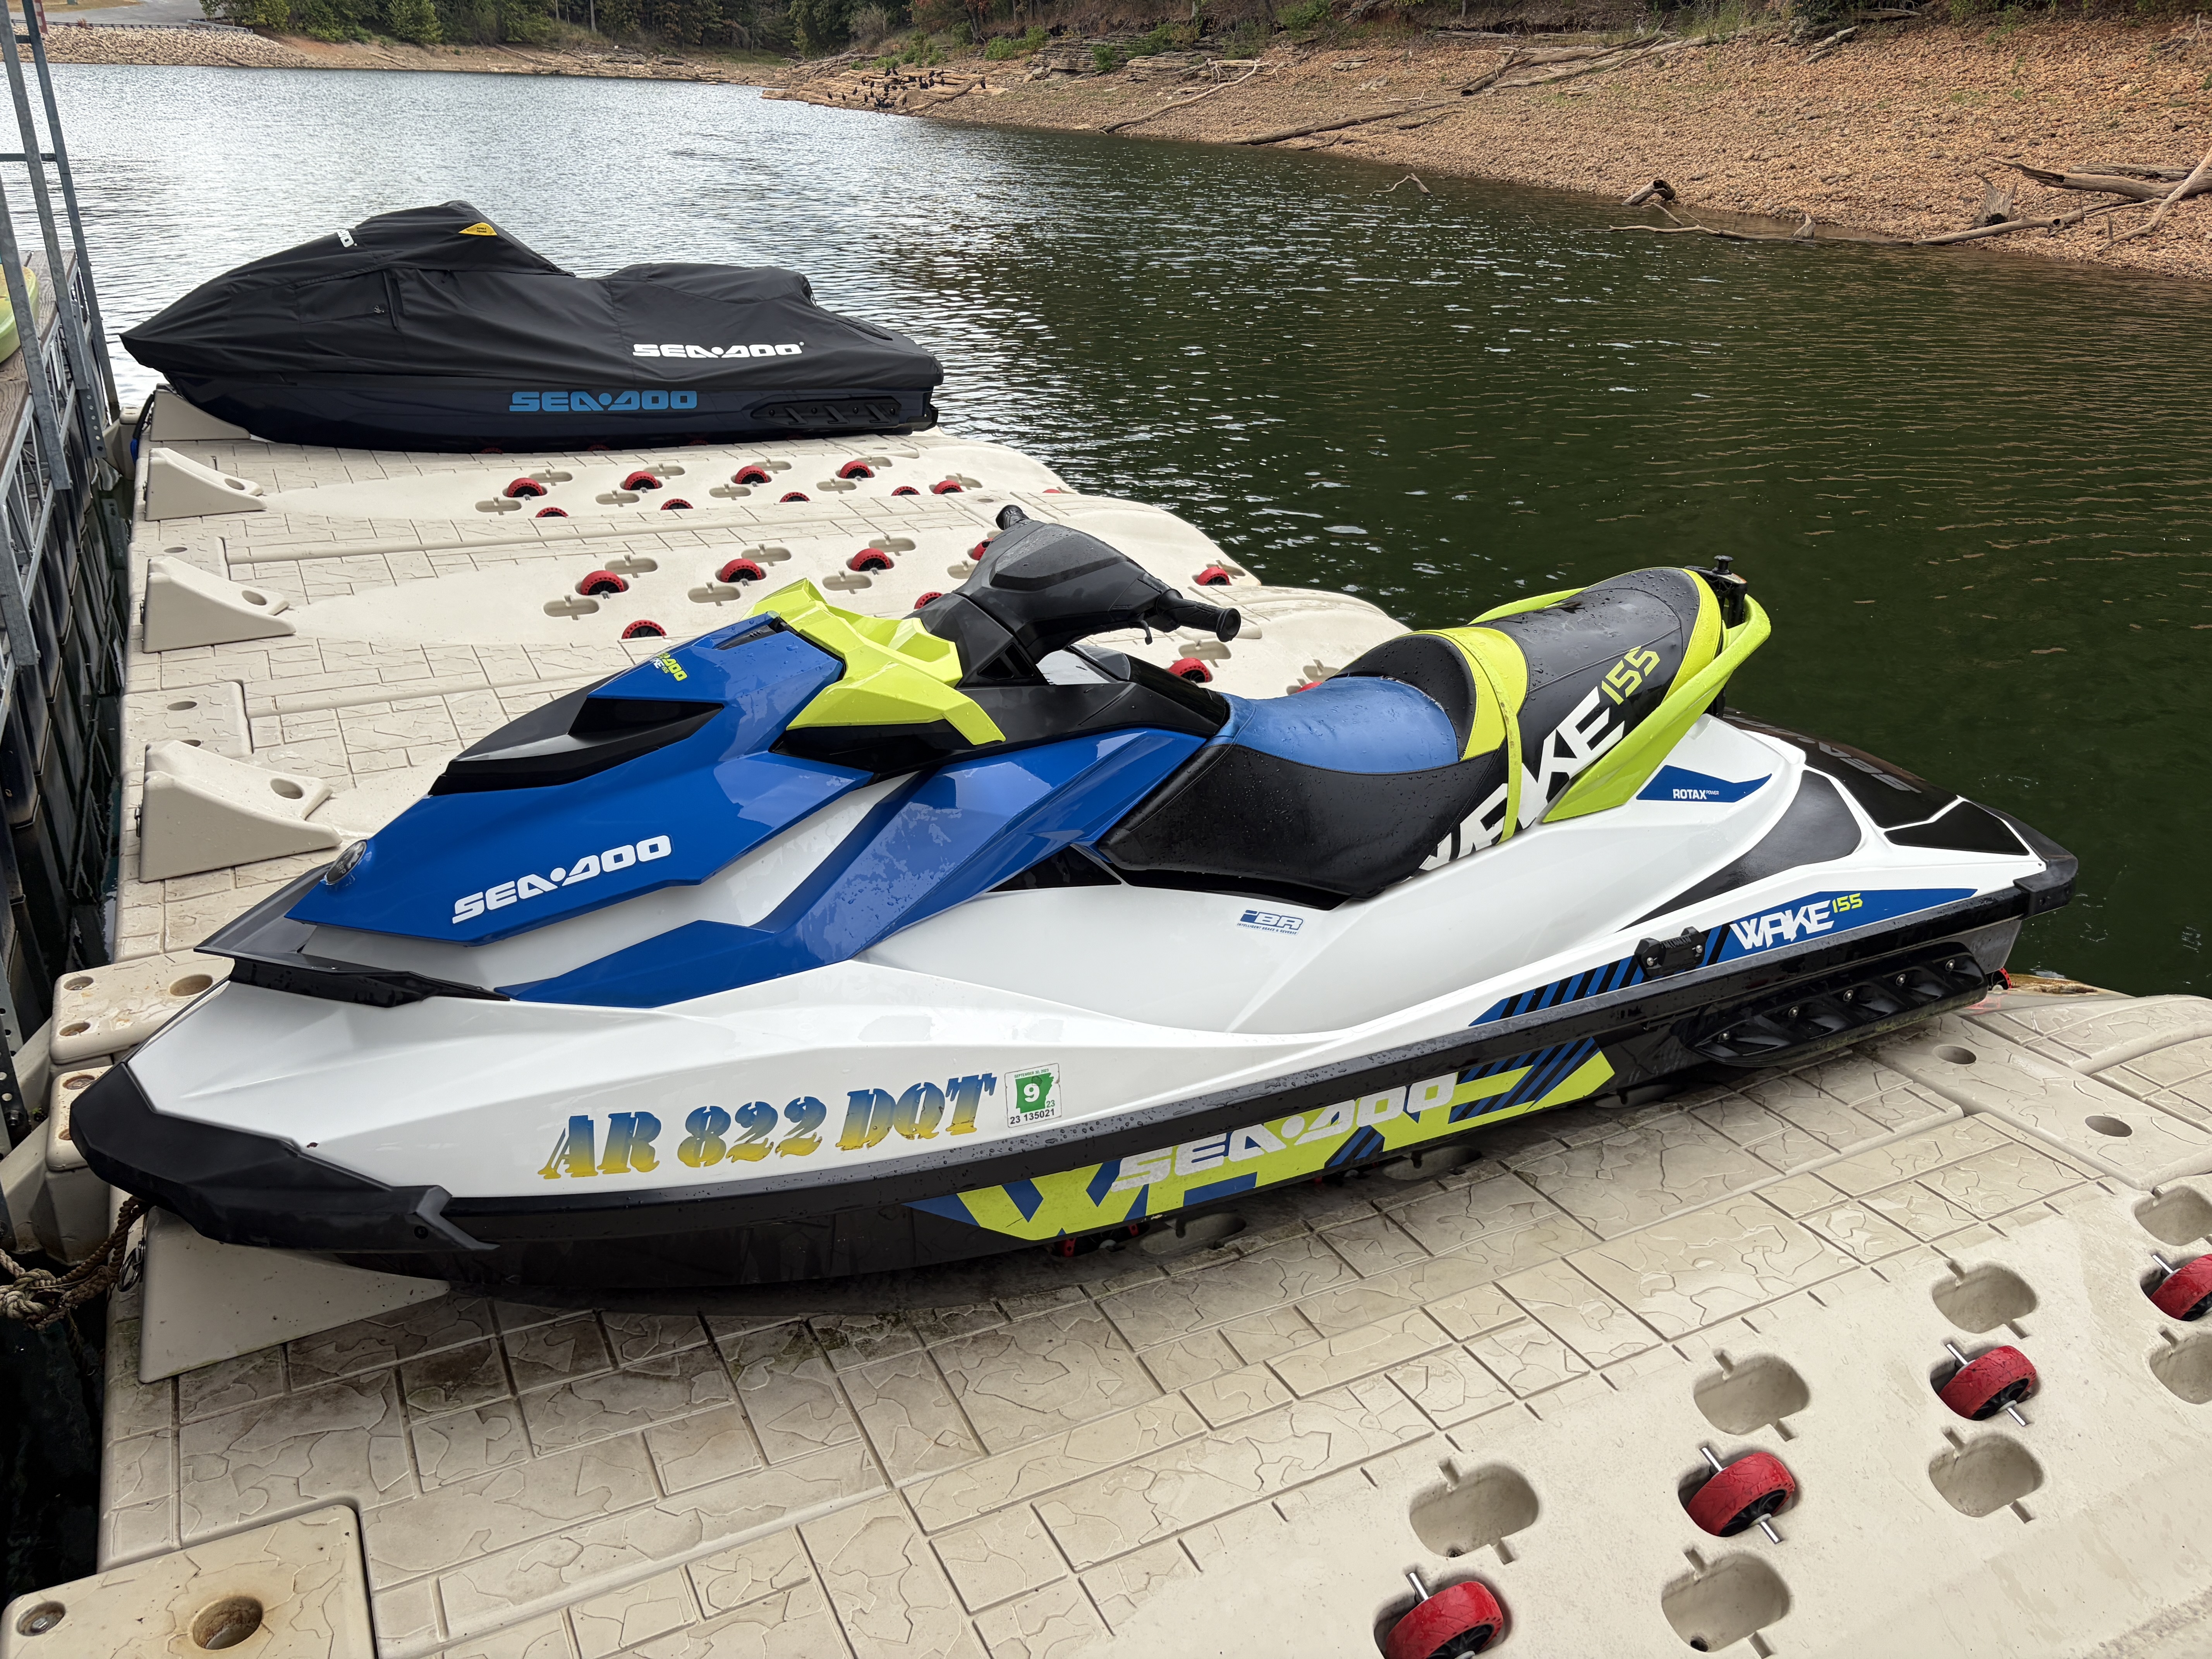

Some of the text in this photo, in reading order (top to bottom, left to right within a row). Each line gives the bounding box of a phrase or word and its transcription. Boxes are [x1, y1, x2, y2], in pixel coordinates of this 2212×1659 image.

[1601, 645, 1660, 705] 155
[1673, 789, 1707, 800] ROTAX
[1729, 893, 1863, 950] WAKE 155
[1024, 1083, 1040, 1103] 9
[1046, 1099, 1055, 1108] 23
[1010, 1108, 1054, 1124] 23 135021
[538, 1114, 661, 1180] AR
[678, 1096, 827, 1168] 822
